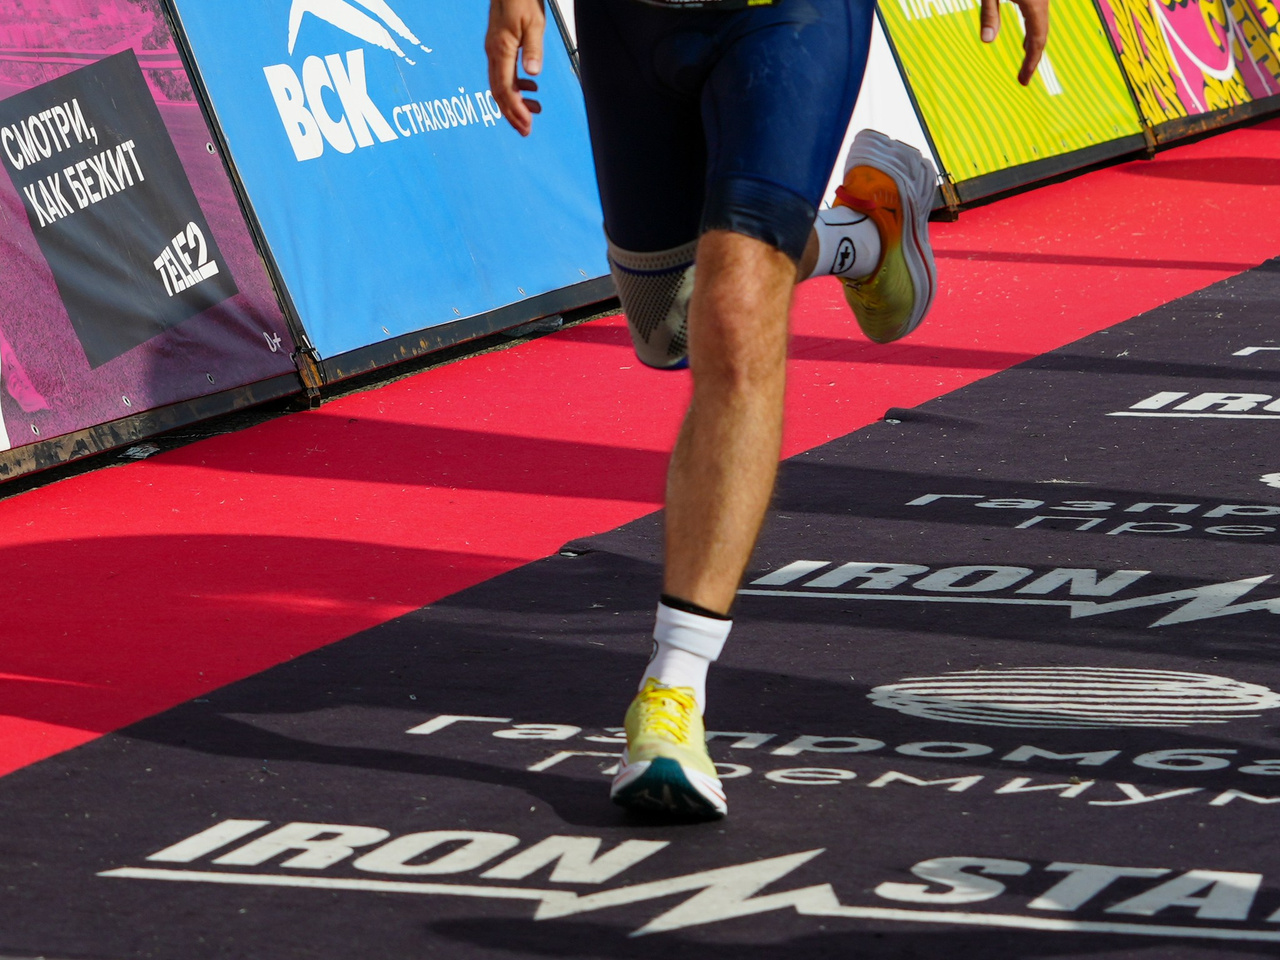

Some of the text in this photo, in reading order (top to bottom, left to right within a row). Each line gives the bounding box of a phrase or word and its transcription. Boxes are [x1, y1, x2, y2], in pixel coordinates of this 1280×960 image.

[0, 98, 99, 170] СМОТРИ,
[262, 48, 505, 162] ВСК СТРАХОВОЙ ДО
[23, 139, 145, 228] КАК БЕЖИТ
[153, 221, 220, 297] TELE2
[749, 559, 1152, 598] IRON
[146, 819, 1280, 923] IRON STA
